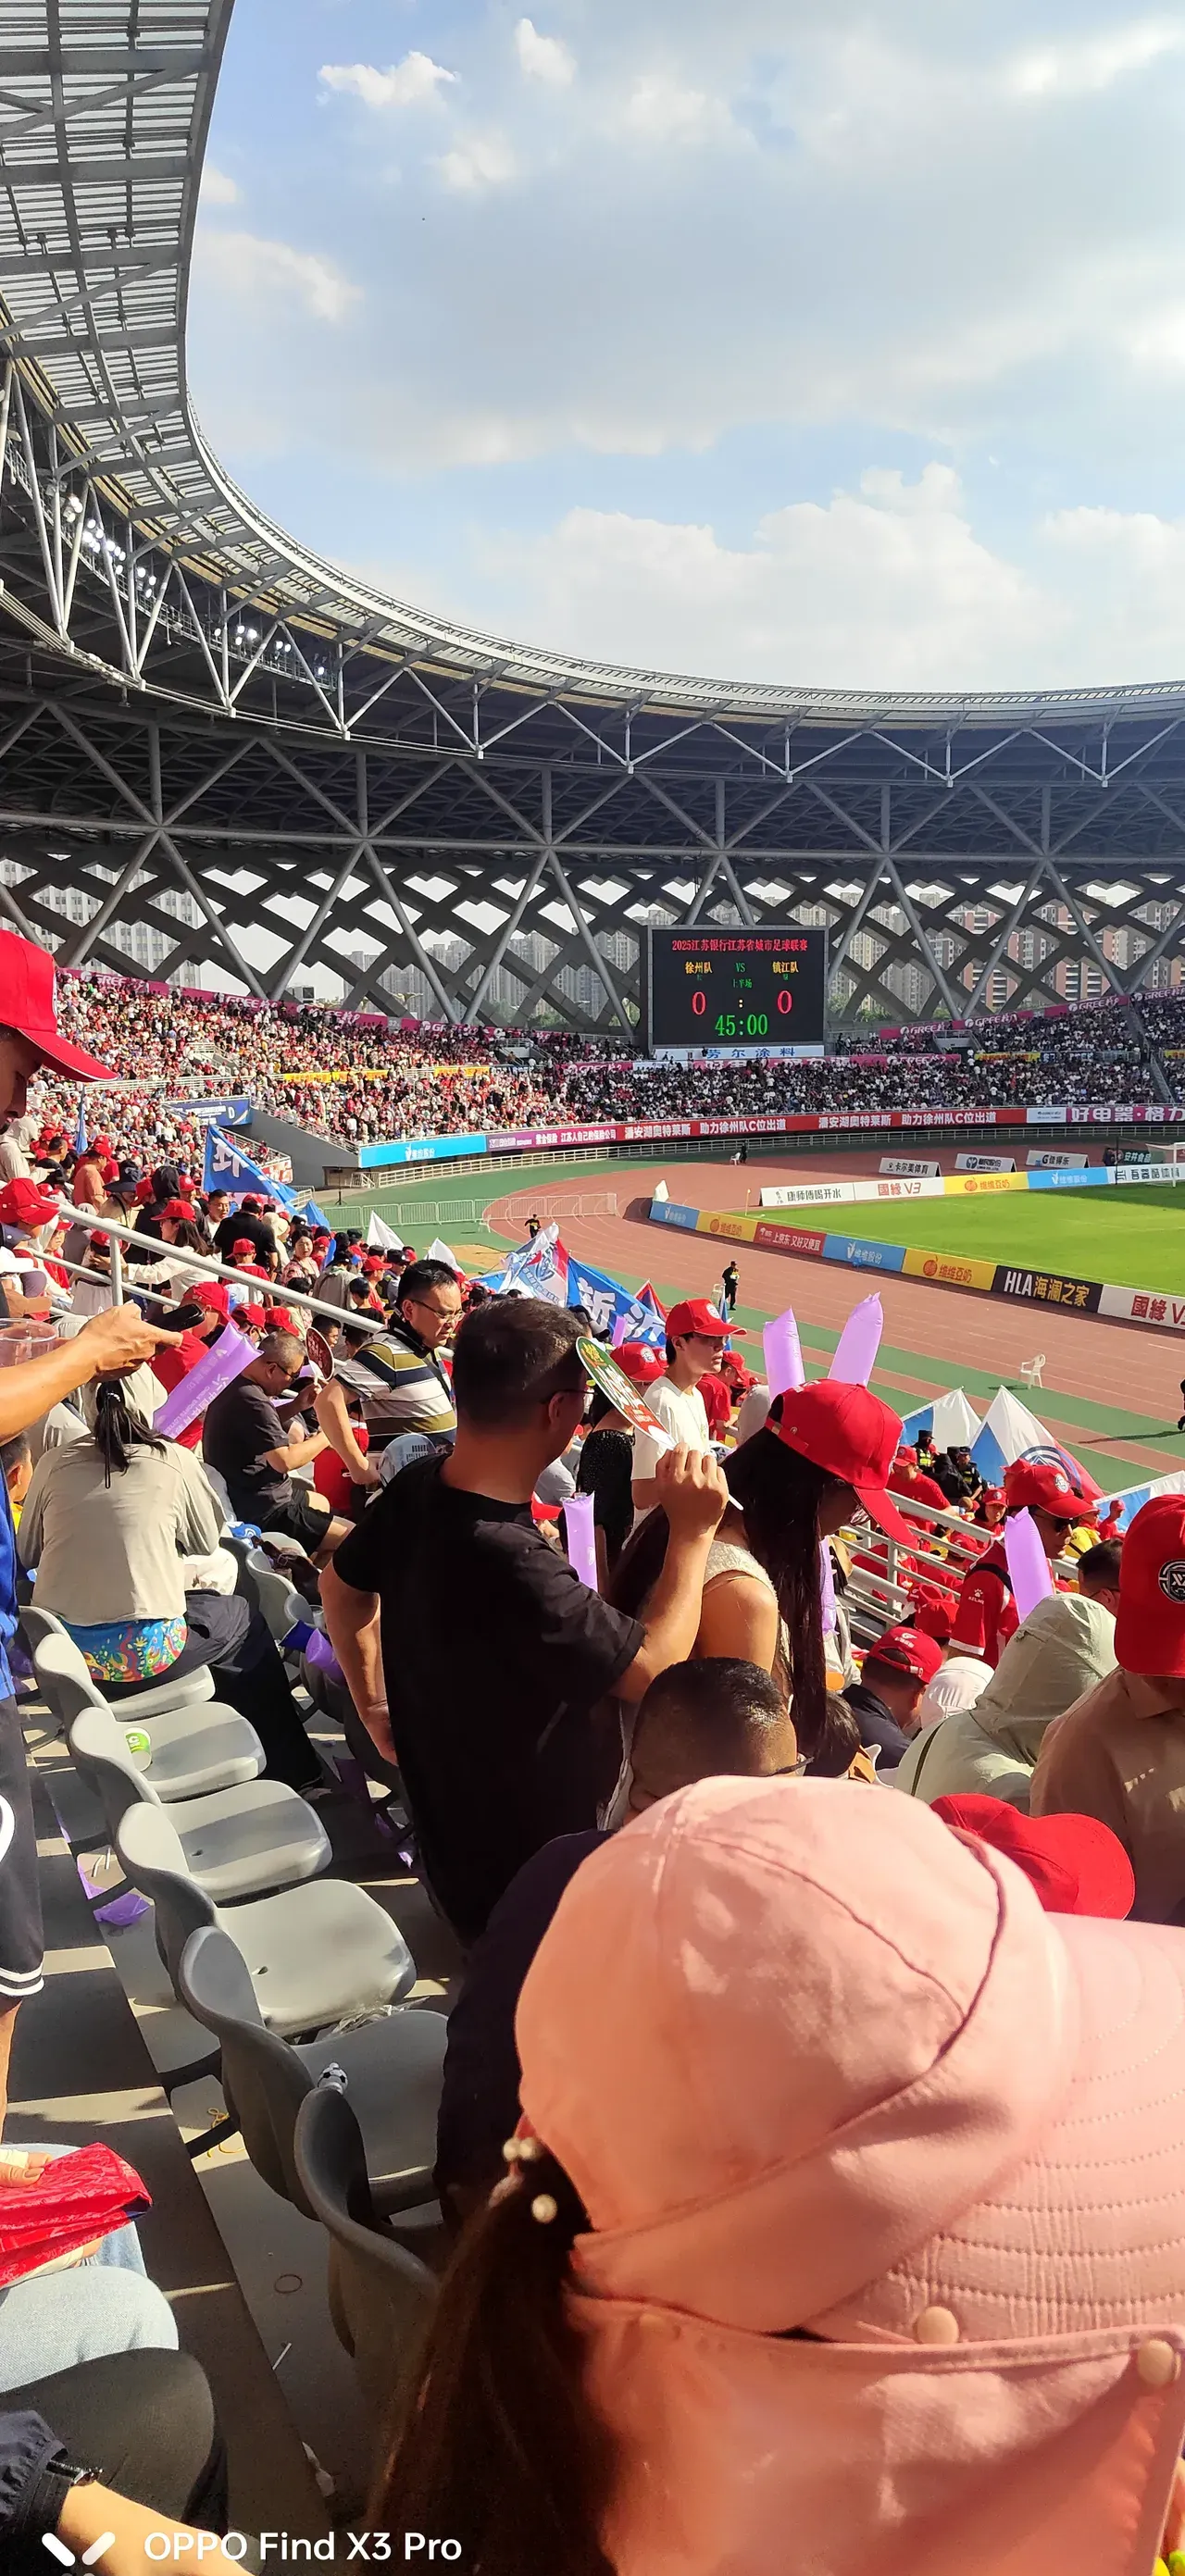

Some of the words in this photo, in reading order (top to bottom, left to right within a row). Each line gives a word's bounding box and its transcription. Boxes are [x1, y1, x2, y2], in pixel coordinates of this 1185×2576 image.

[672, 939, 808, 952] 2025江苏银行江苏省城市足球联赛
[684, 961, 713, 975] 徐州队
[735, 963, 746, 973] VS
[772, 961, 799, 974] 镇江队
[692, 991, 706, 1015] 0
[777, 990, 792, 1014] 0
[1079, 1000, 1105, 1010] GREE
[715, 1014, 768, 1037] 45:00
[228, 1107, 235, 1119] D
[818, 1114, 892, 1129] 潘安湖奥特莱斯
[902, 1111, 997, 1125] 助力徐州队C位出道
[624, 1124, 691, 1139] 潘安湖奥特莱斯
[700, 1118, 787, 1135] 助力徐州队C位出道
[561, 1129, 617, 1142] 江苏人自己的保险公司
[1124, 1151, 1152, 1163] 安井食品
[894, 1163, 929, 1175] 卡尔美体育
[904, 1182, 922, 1194] V3
[772, 1232, 792, 1246] 上京东
[791, 1235, 821, 1251] 又好又便宜
[939, 1264, 972, 1284] 维维豆奶
[1004, 1271, 1033, 1297] HLA
[1033, 1276, 1091, 1307] 海澜之家
[1129, 1294, 1166, 1322] 國緣
